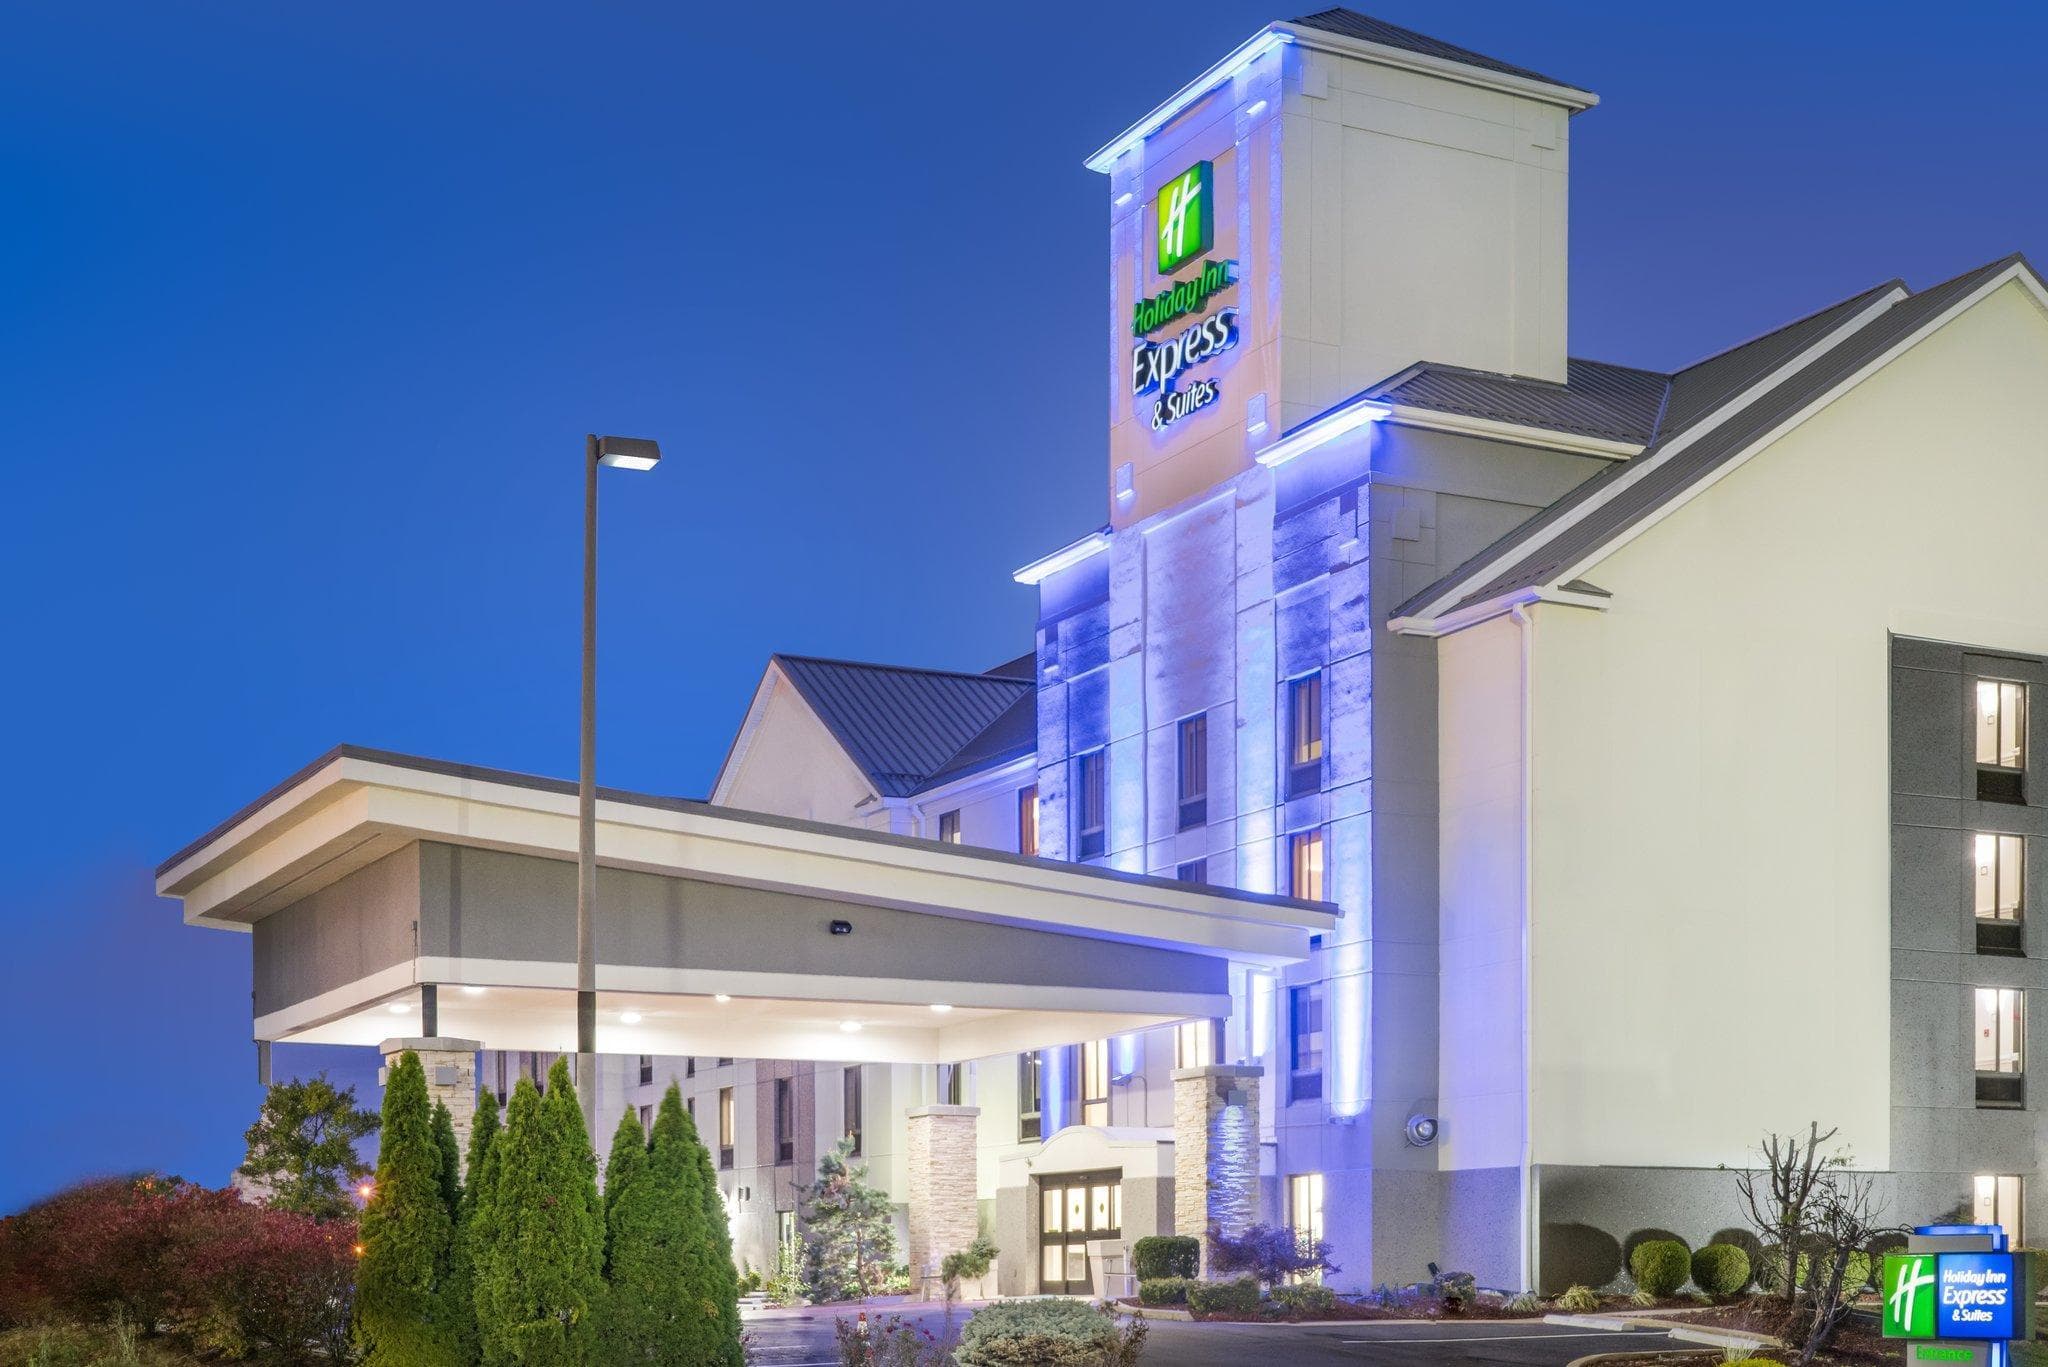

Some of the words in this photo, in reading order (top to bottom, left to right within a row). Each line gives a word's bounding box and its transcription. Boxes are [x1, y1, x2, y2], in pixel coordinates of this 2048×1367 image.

[1161, 173, 1202, 257] H
[1132, 279, 1200, 334] Holiday
[1200, 260, 1230, 296] Inn
[1132, 311, 1230, 395] Express
[1151, 400, 1163, 431] &
[1166, 382, 1214, 423] Suites
[1889, 1258, 1935, 1332] H
[1943, 1269, 1986, 1285] Holiday
[1986, 1269, 2007, 1283] Inn
[1943, 1286, 2007, 1309] Express
[1952, 1310, 1961, 1322] &
[1961, 1309, 1993, 1322] Suites
[1916, 1345, 1973, 1361] Entrance
